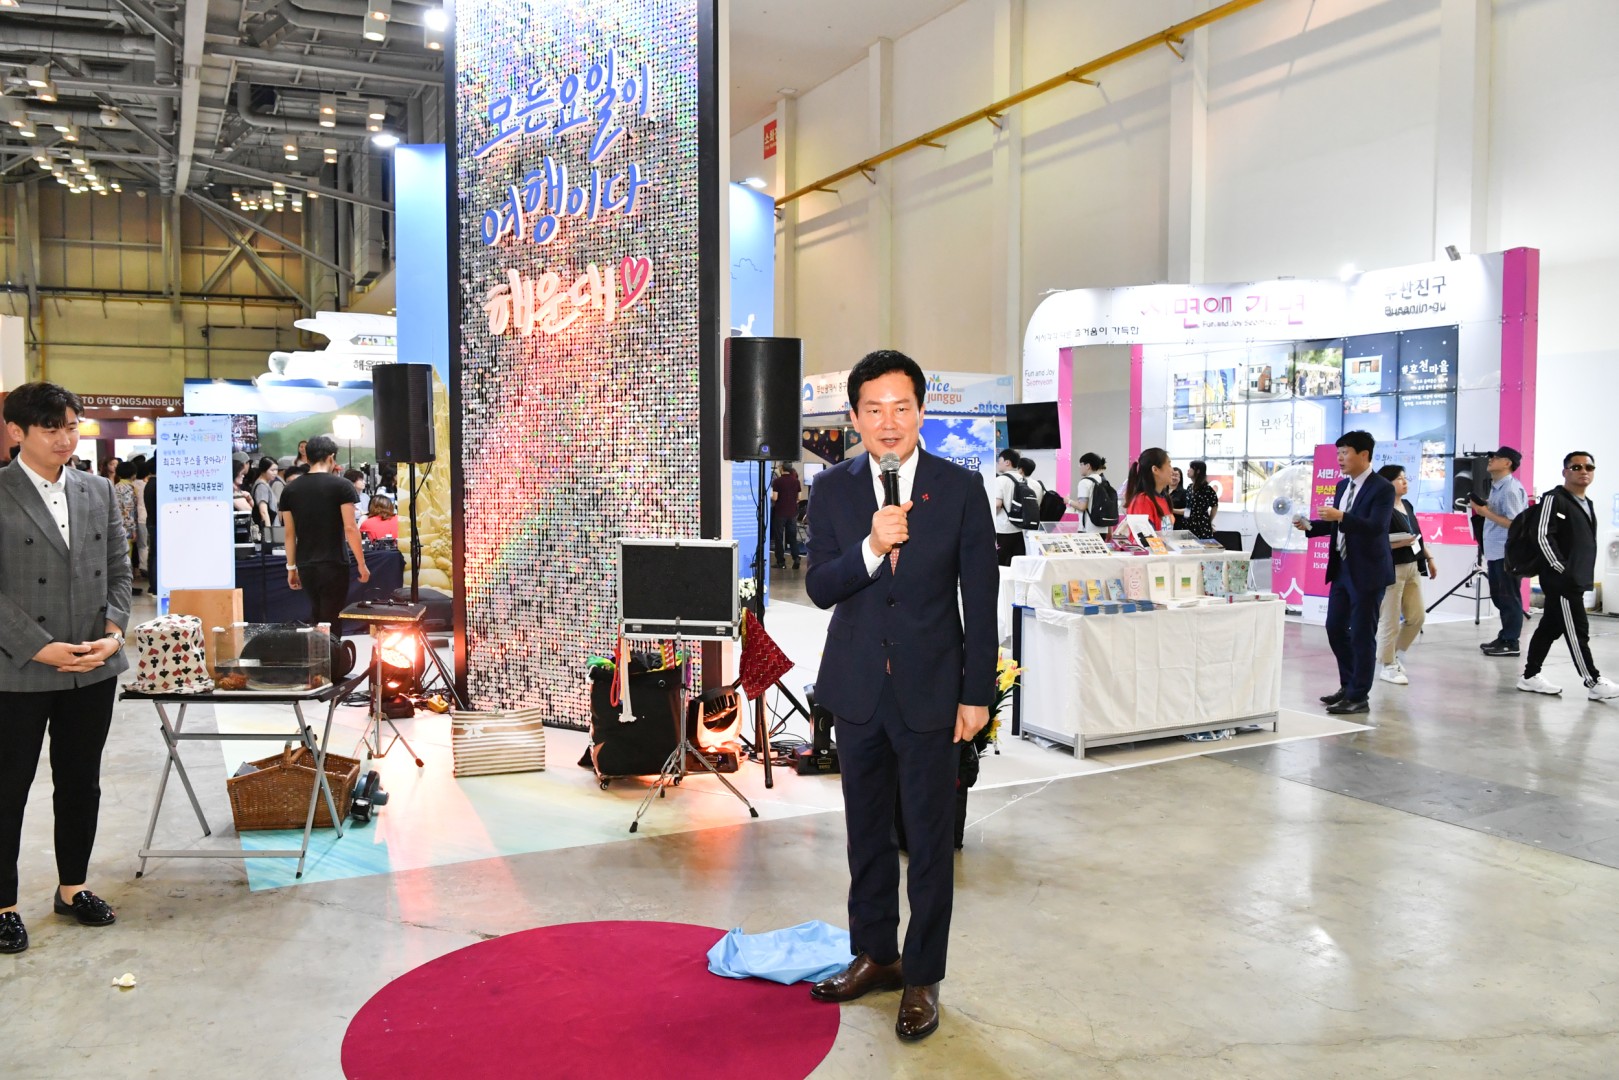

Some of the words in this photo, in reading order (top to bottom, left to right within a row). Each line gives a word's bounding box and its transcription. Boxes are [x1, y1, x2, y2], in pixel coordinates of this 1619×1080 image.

[481, 156, 649, 246] 여행이다
[483, 263, 617, 337] 해운대
[1074, 326, 1108, 337] 즐거움이
[1111, 326, 1140, 335] 가득한
[925, 381, 950, 393] Nice
[82, 396, 94, 405] TO
[926, 392, 962, 405] junggu
